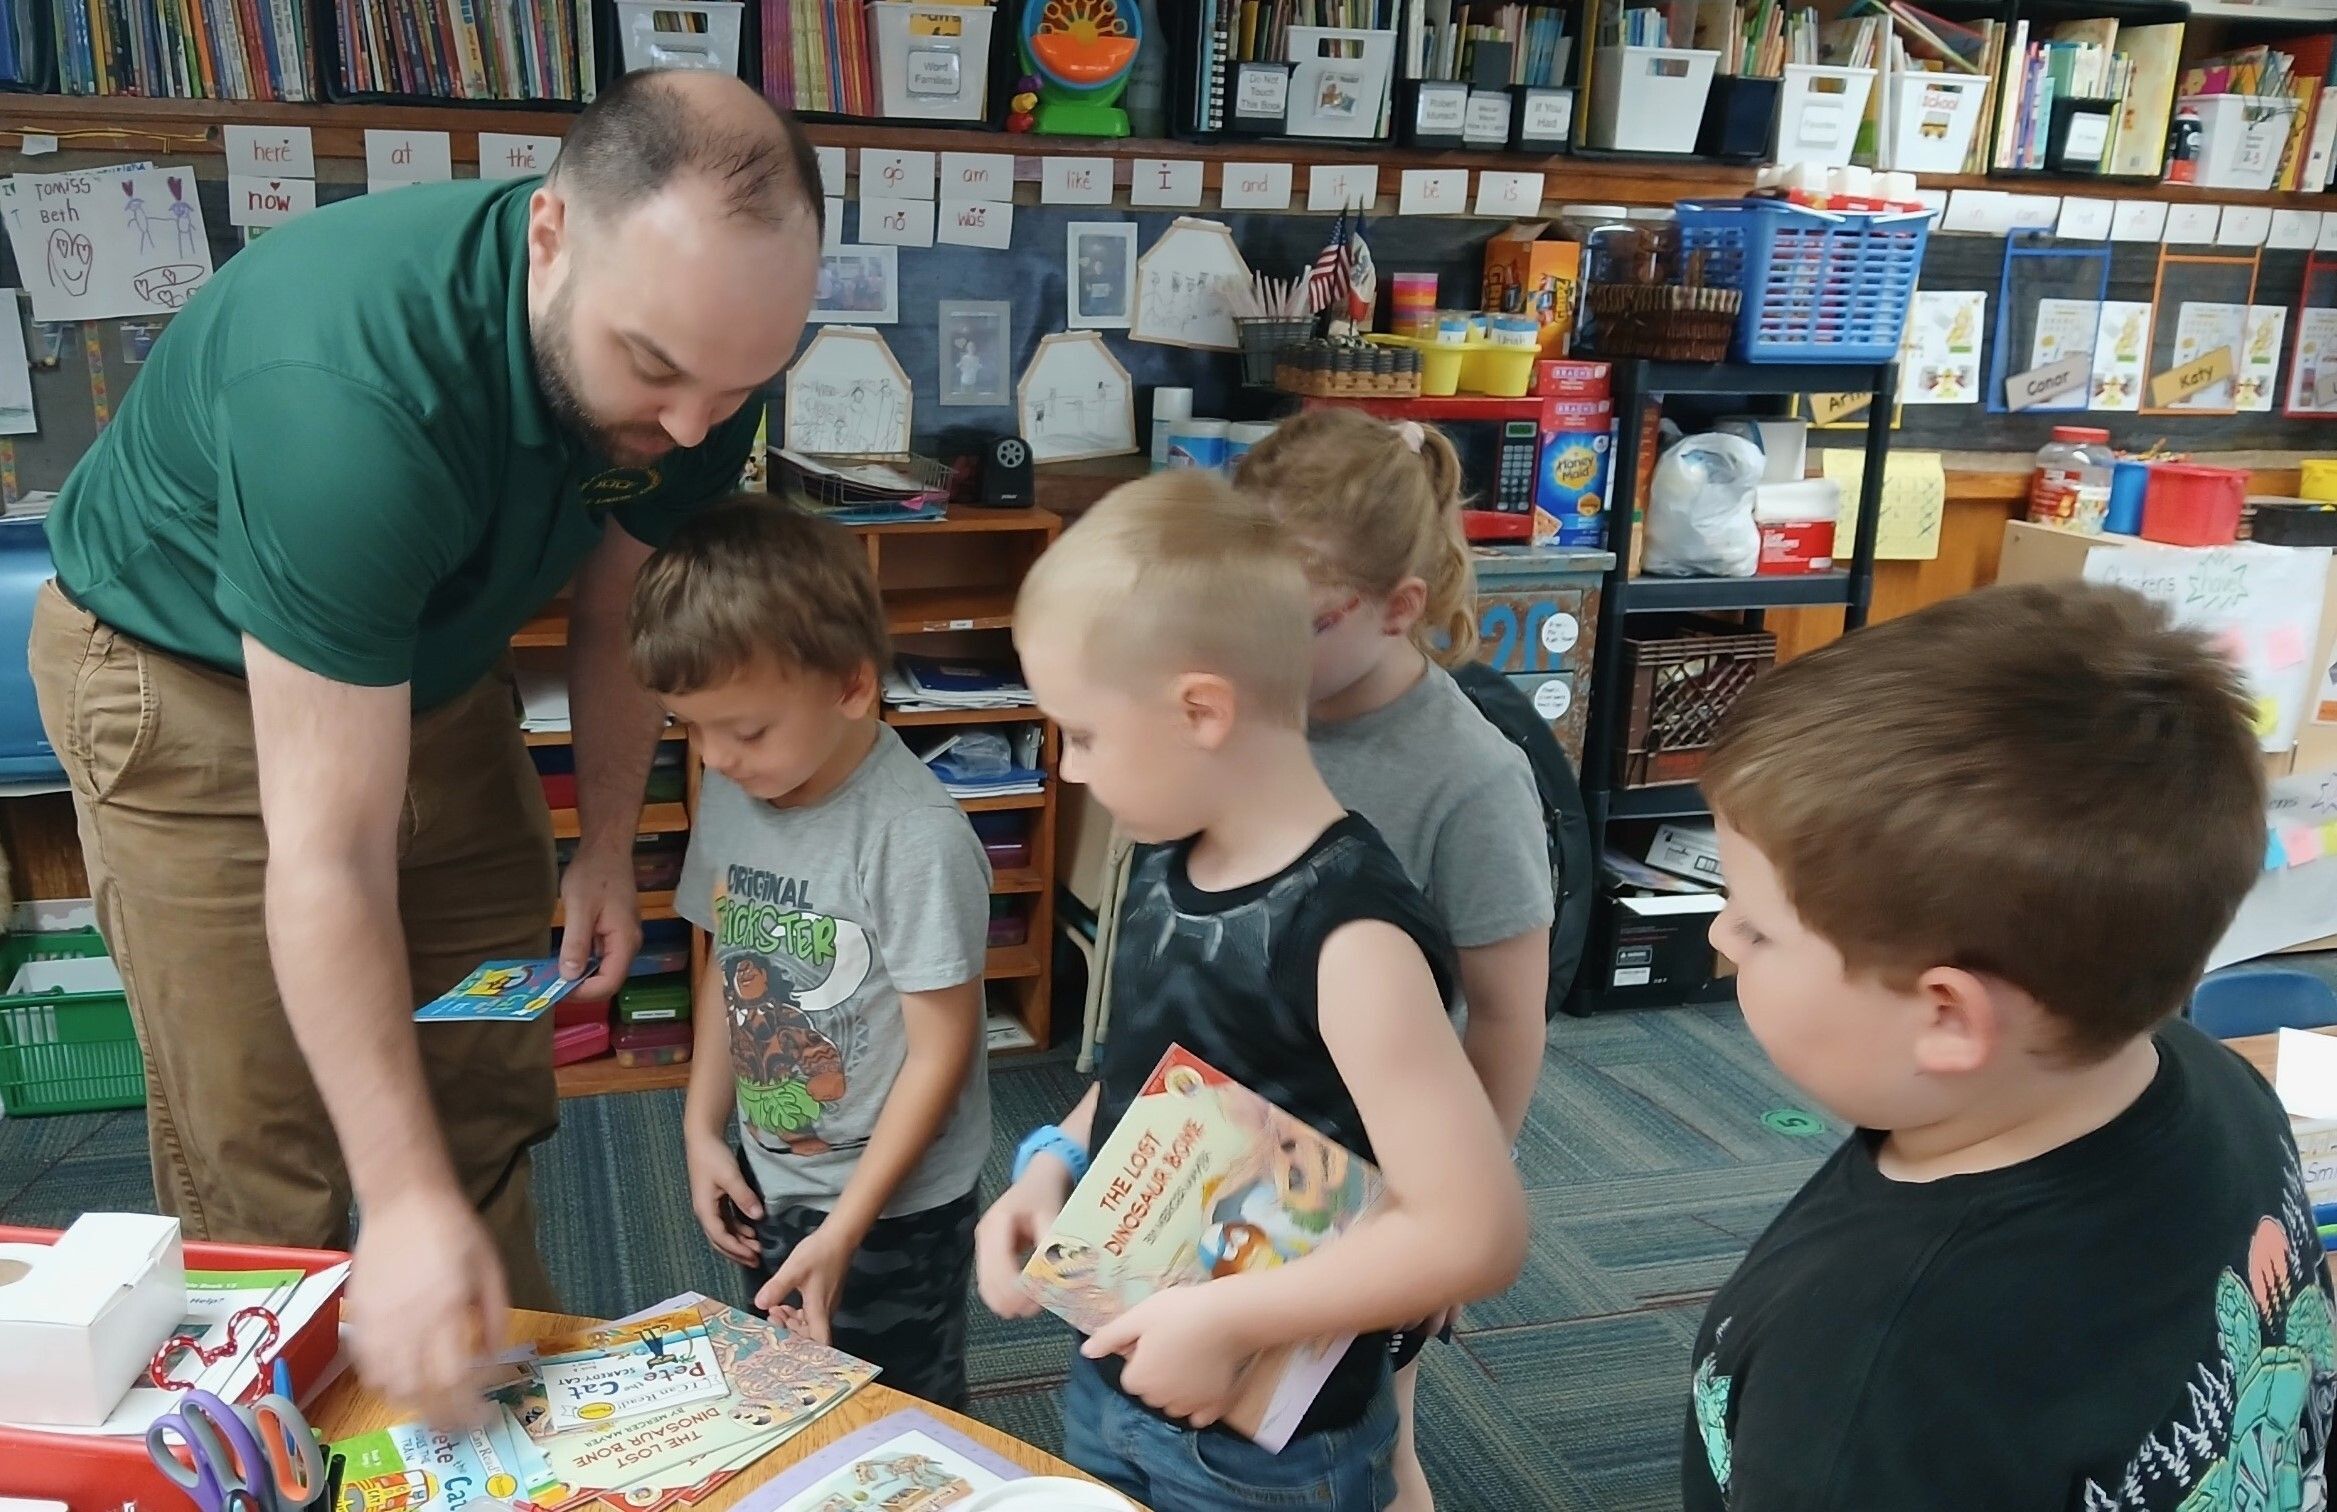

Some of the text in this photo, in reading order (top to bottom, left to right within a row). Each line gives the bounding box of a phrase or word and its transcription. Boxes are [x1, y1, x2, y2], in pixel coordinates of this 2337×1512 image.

[253, 139, 293, 163] here
[391, 141, 413, 165] at
[506, 146, 537, 169] the
[883, 165, 905, 188] go
[963, 168, 989, 183] am
[1066, 171, 1093, 190] like
[1158, 170, 1172, 190] I
[1241, 174, 1268, 193] and
[1332, 174, 1347, 196] it
[40, 198, 80, 223] Beth
[248, 190, 291, 212] now
[883, 213, 906, 231] no
[957, 211, 986, 228] was
[1556, 456, 1594, 470] Honey
[1562, 467, 1590, 481] Maid
[1099, 1128, 1162, 1212] THE LOST
[1104, 1167, 1168, 1257] DINOSAUR
[568, 1361, 707, 1400] Pete the Cat
[660, 1384, 689, 1395] Can
[572, 1407, 721, 1469] DINOSAUR BONE
[584, 1407, 687, 1448] BY MERCER MAYER
[430, 1426, 460, 1464] ete
[665, 1430, 704, 1449] THE
[617, 1445, 662, 1469] LOST
